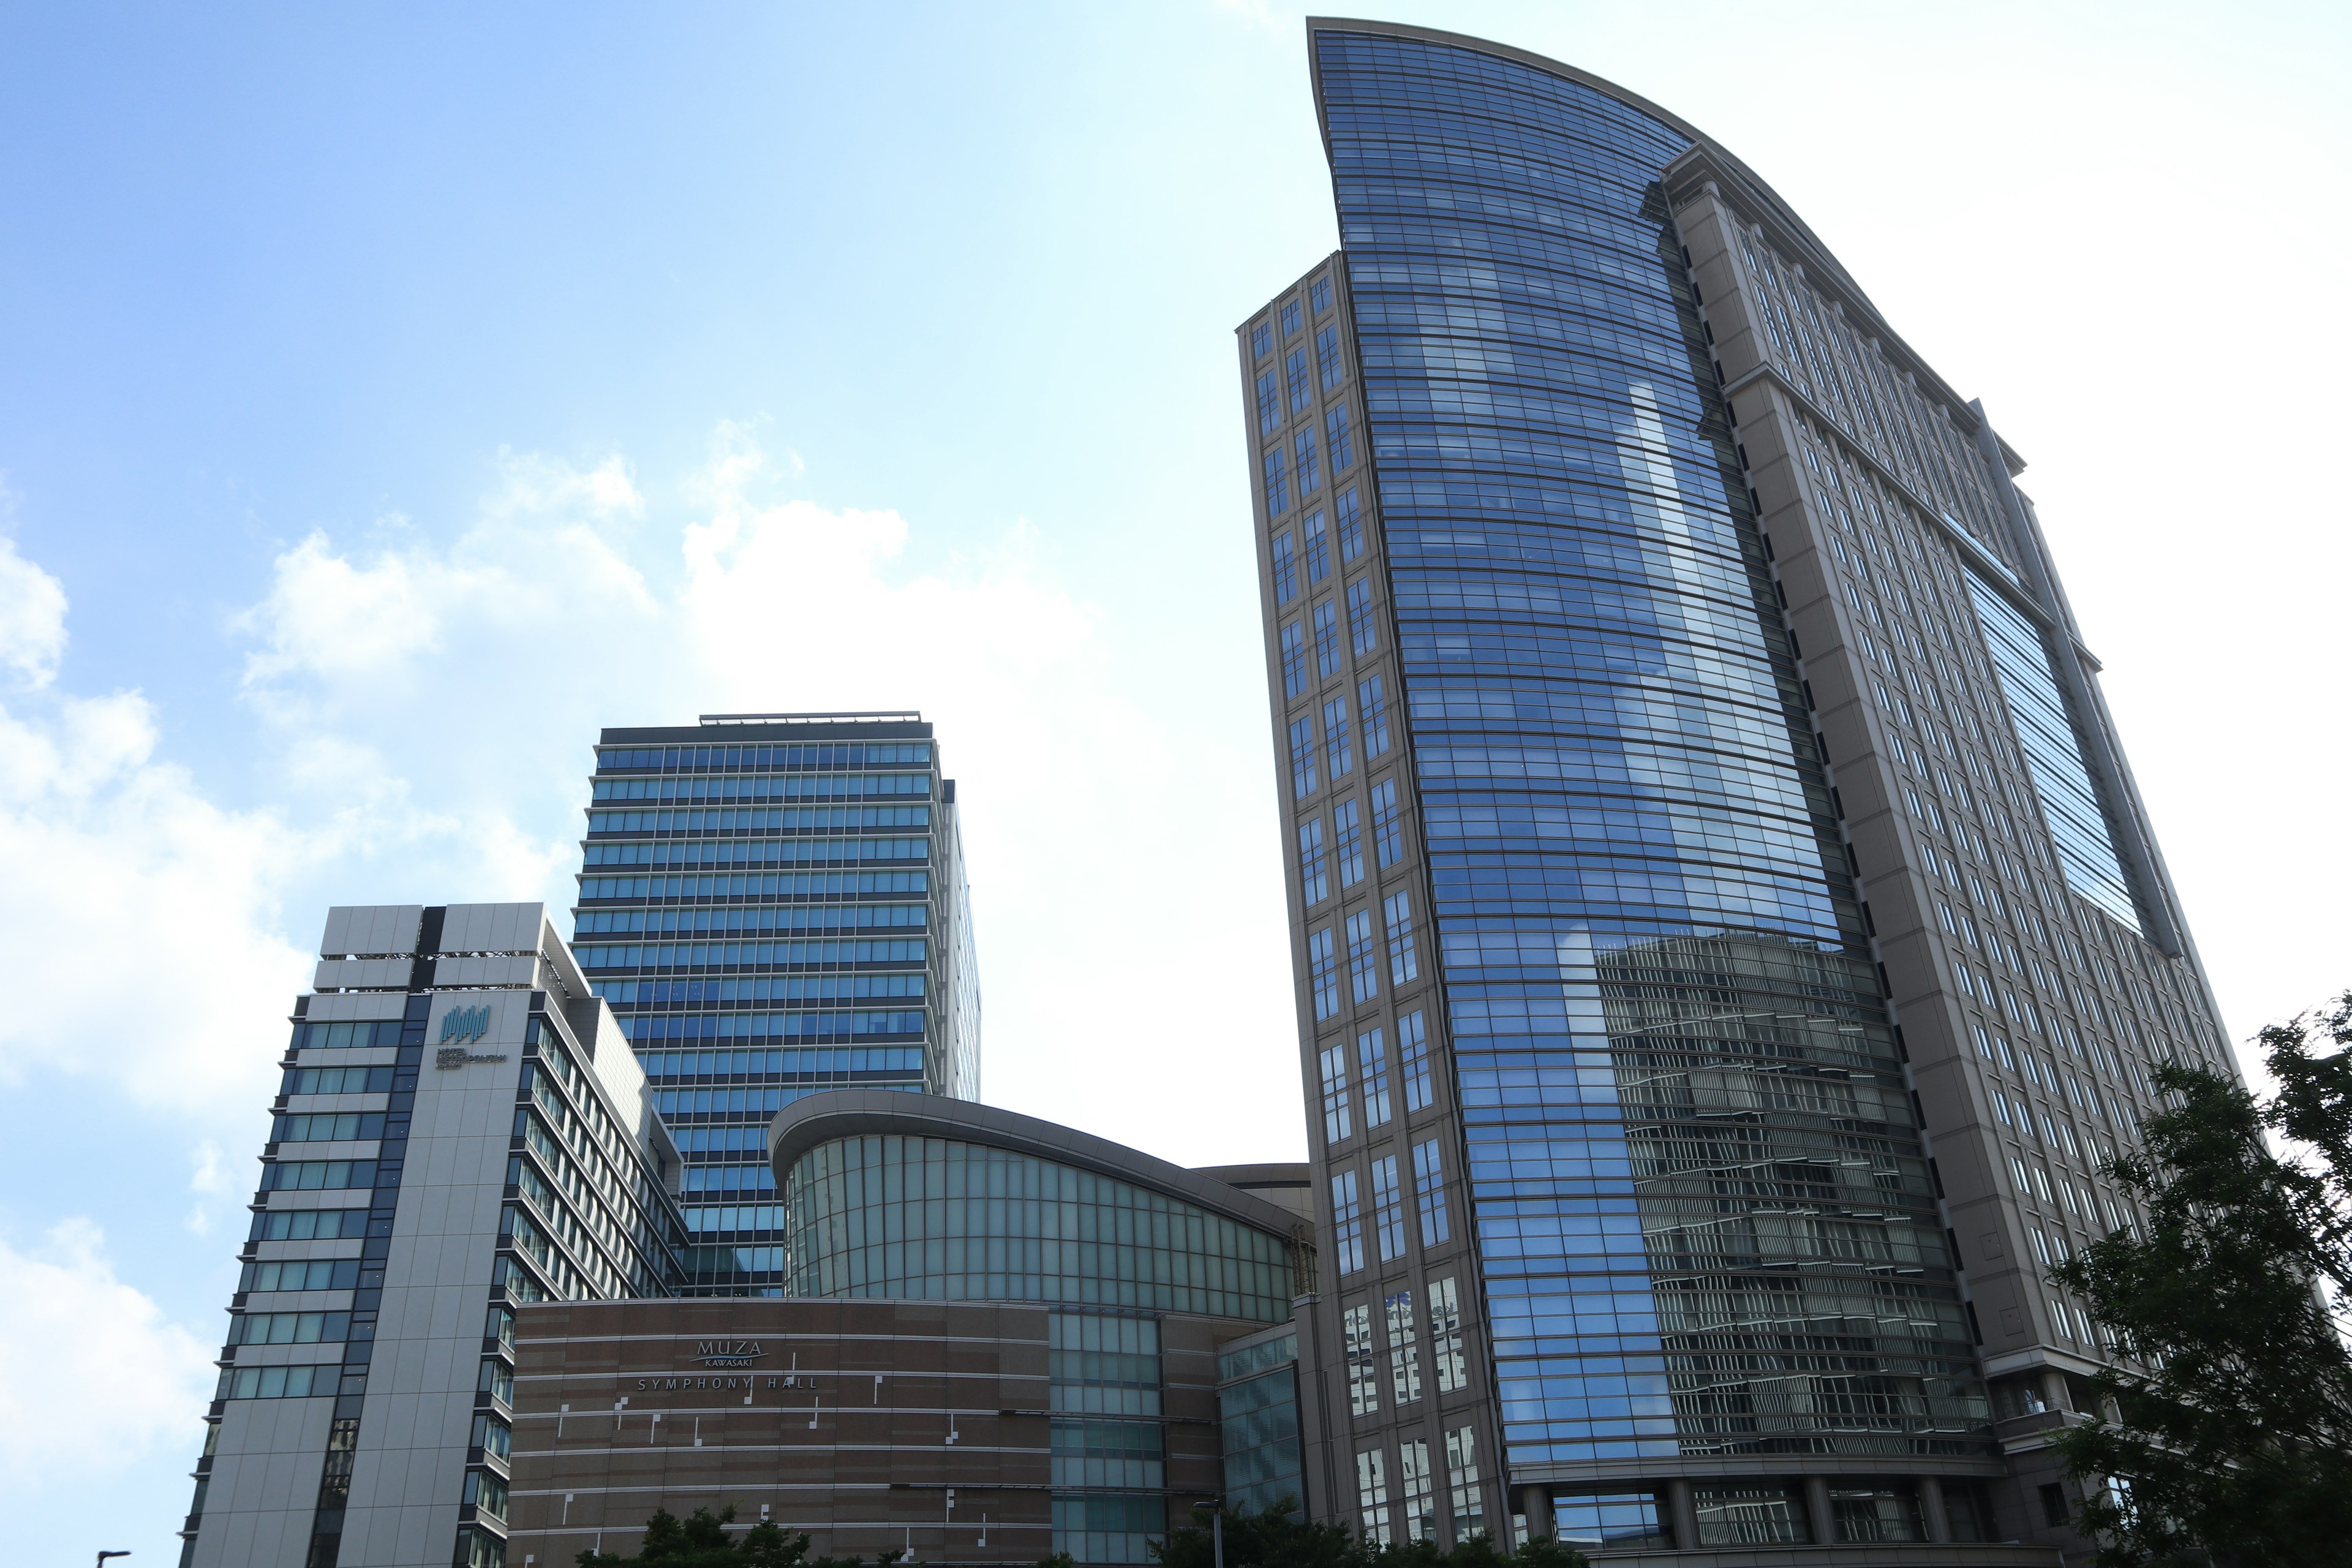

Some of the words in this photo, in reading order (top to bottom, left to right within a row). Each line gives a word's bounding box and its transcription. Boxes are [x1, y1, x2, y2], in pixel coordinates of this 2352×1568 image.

[435, 1055, 507, 1063] METROPOLITAN
[696, 1341, 761, 1355] MUZA
[638, 1378, 751, 1390] SYMPHONY
[767, 1378, 816, 1389] HALL
